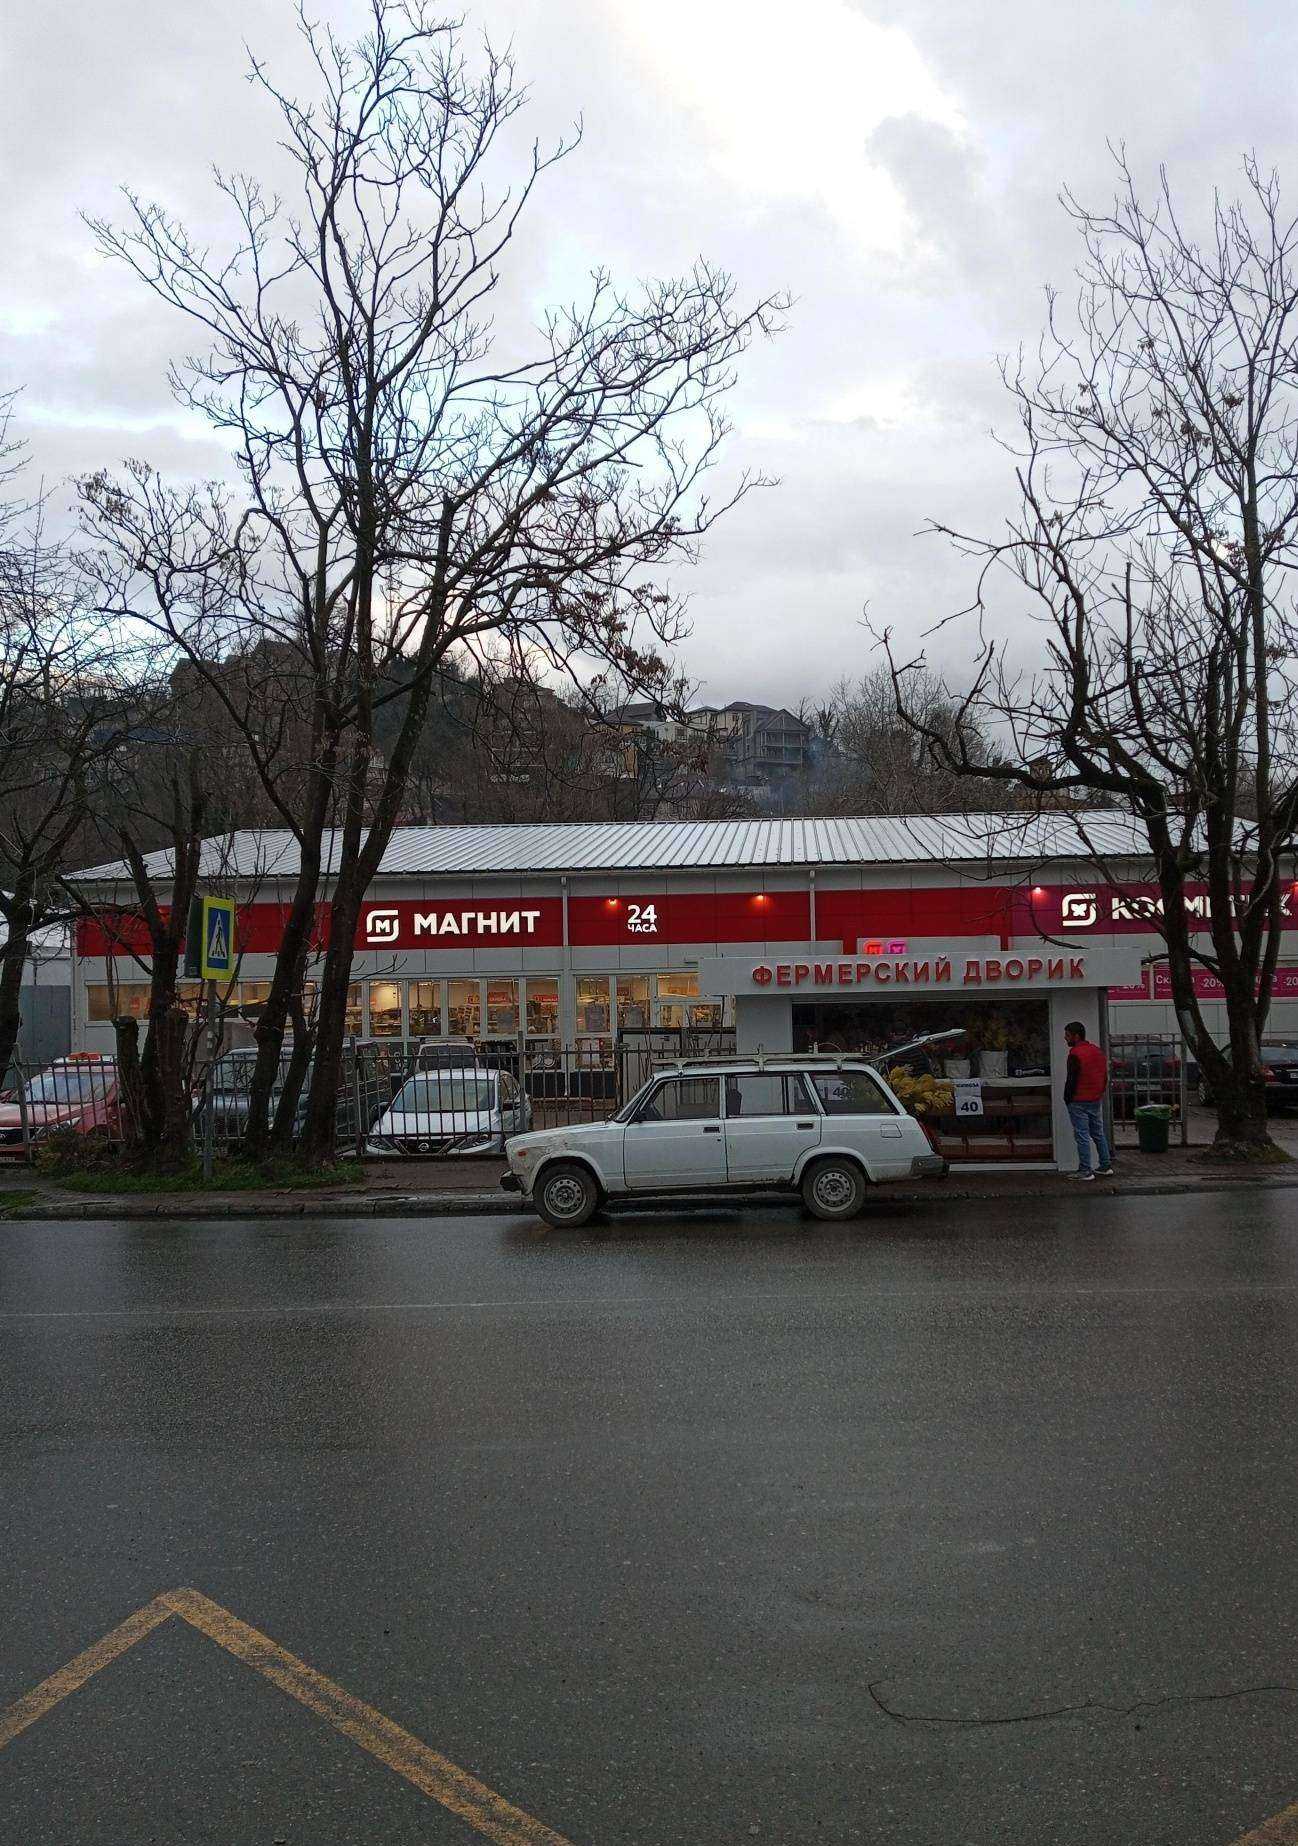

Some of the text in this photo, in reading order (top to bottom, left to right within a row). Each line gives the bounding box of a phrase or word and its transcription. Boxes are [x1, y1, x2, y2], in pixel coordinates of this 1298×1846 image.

[413, 911, 541, 935] МАГНИТ
[627, 904, 658, 924] 24
[627, 923, 658, 933] ЧАСА
[752, 955, 951, 986] ФЕРМЕРСКИЙ
[963, 957, 1085, 985] ДВОРИК
[960, 1101, 979, 1112] 40
